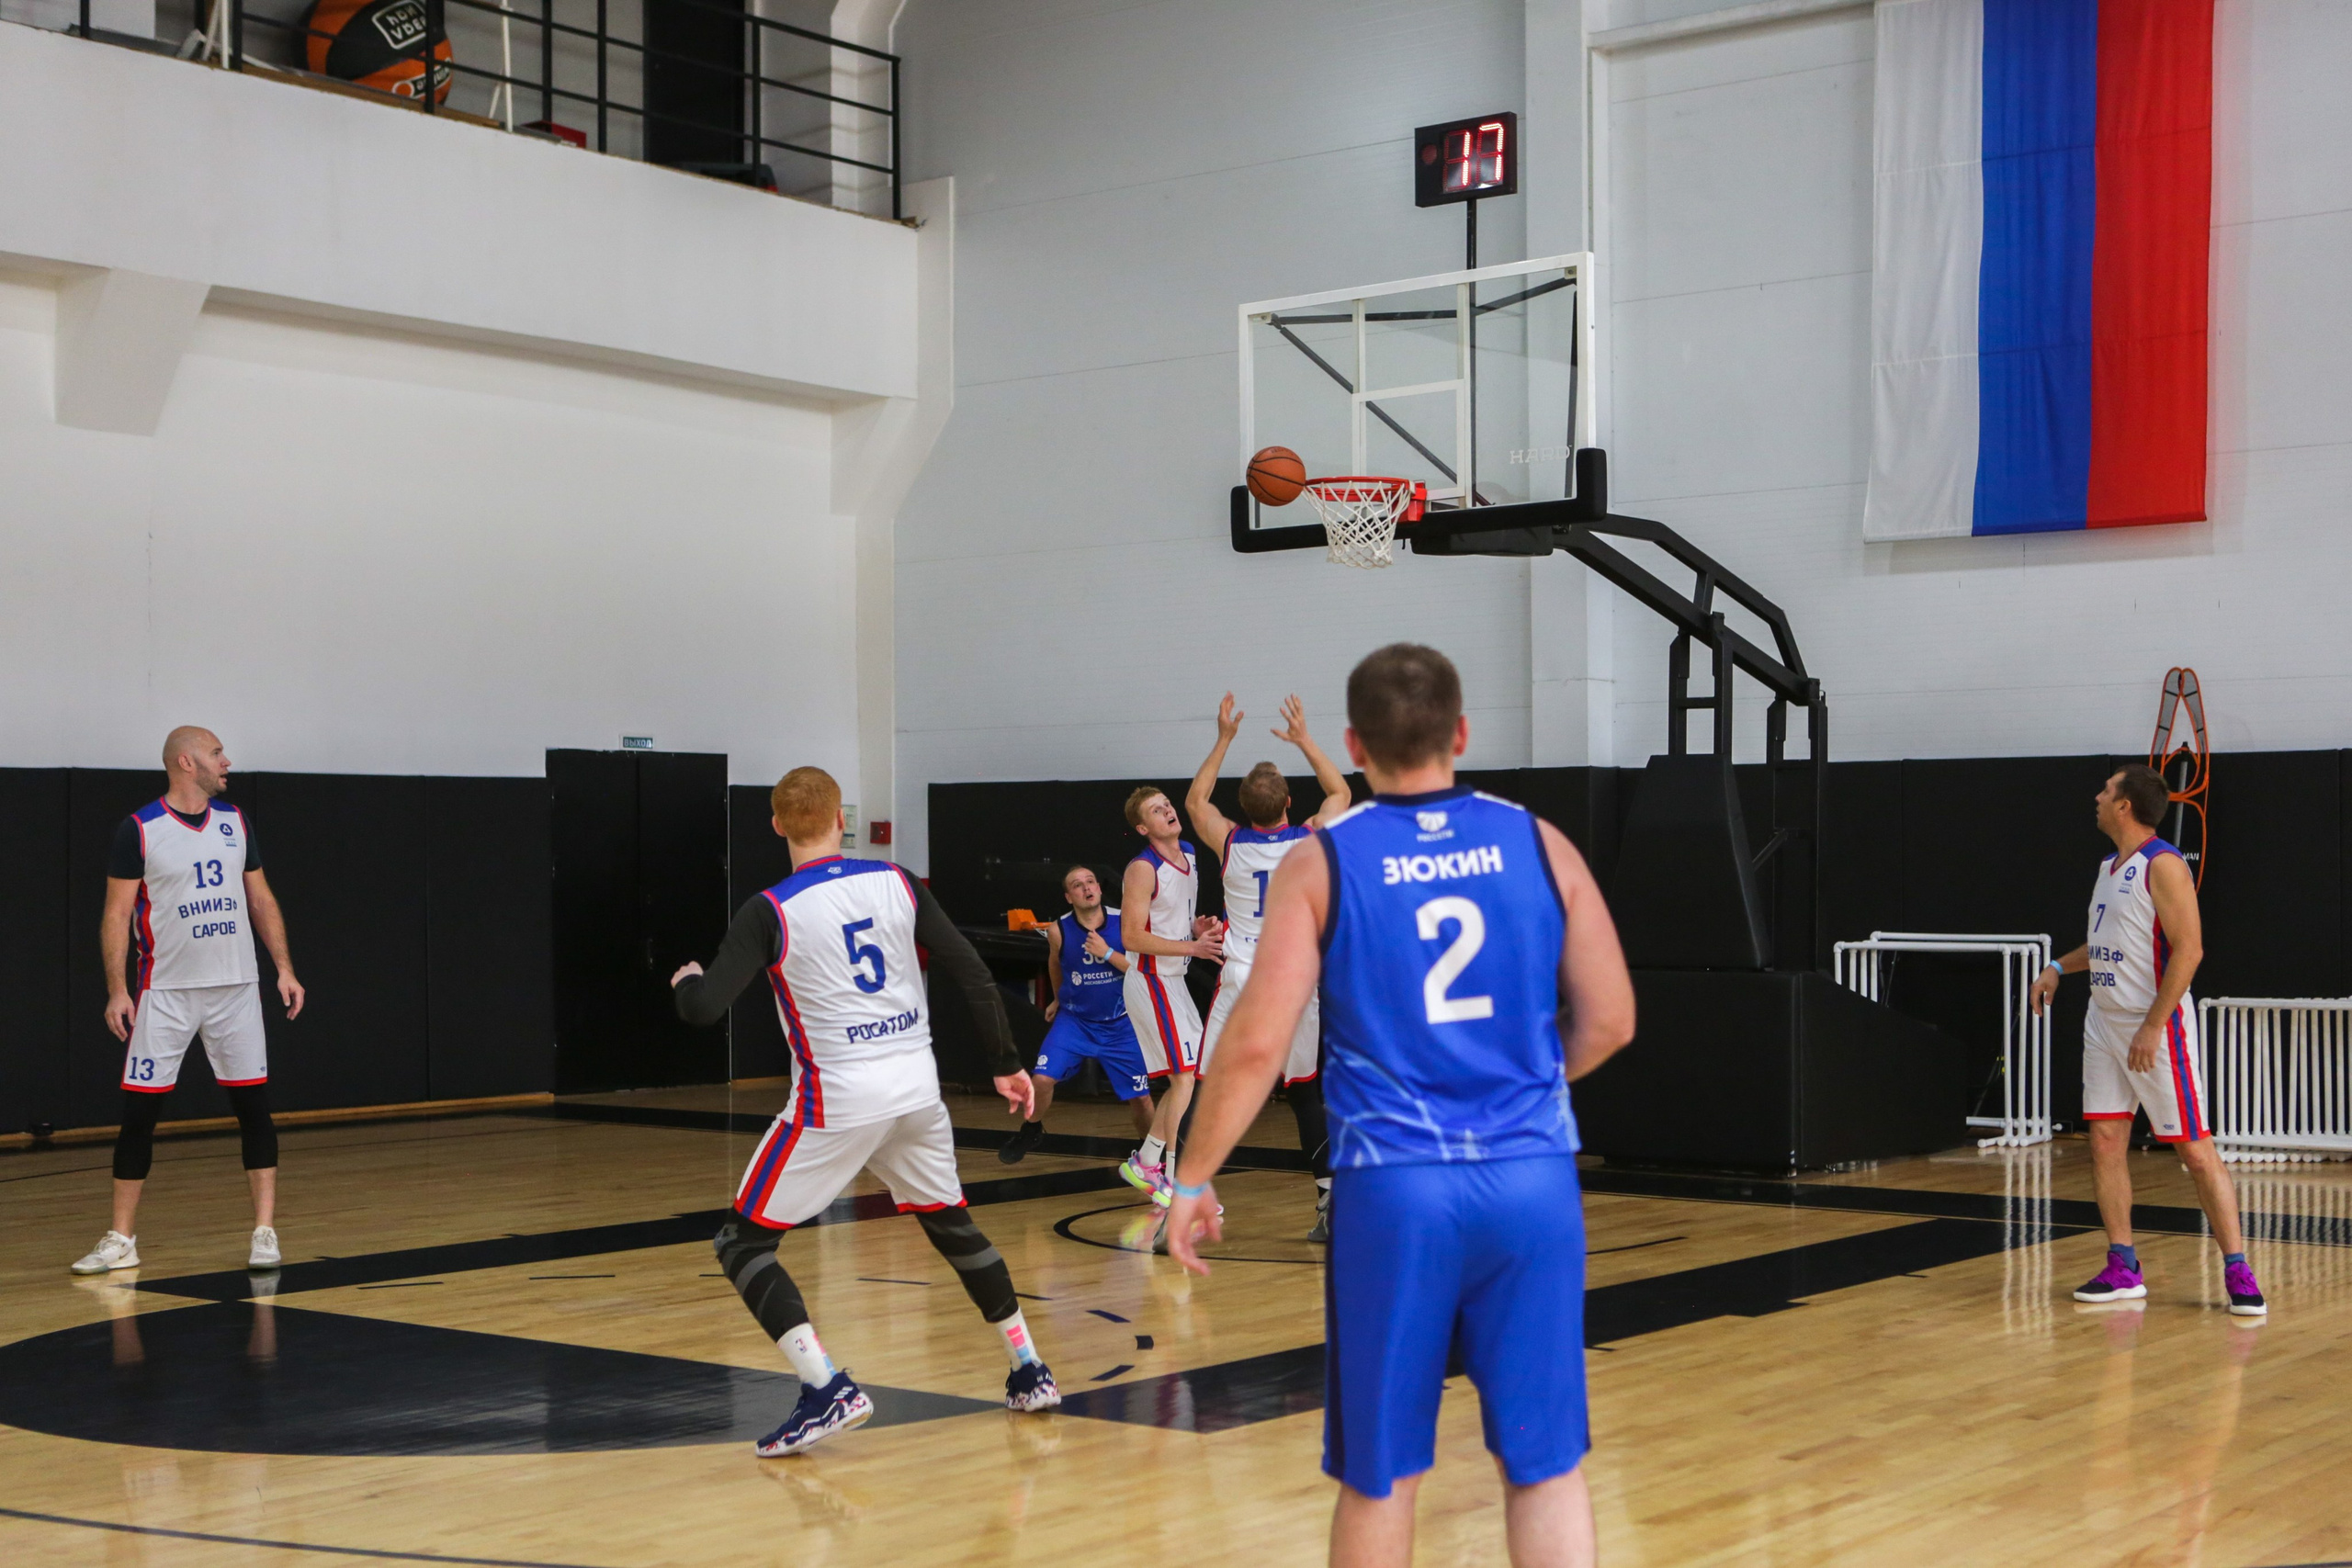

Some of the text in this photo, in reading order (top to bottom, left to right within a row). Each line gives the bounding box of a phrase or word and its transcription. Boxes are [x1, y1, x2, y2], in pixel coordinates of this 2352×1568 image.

[1462, 122, 1504, 186] 17
[624, 739, 652, 749] ВЫХОД
[193, 859, 224, 888] 13
[1382, 845, 1504, 885] ЗЮКИН
[192, 921, 236, 939] САРОВ
[2094, 904, 2106, 933] 7
[842, 917, 887, 994] 5
[1416, 896, 1494, 1024] 2
[1083, 971, 1114, 980] РОССЕТИ
[846, 1008, 918, 1043] РОСАТОМ
[129, 1056, 155, 1081] 13
